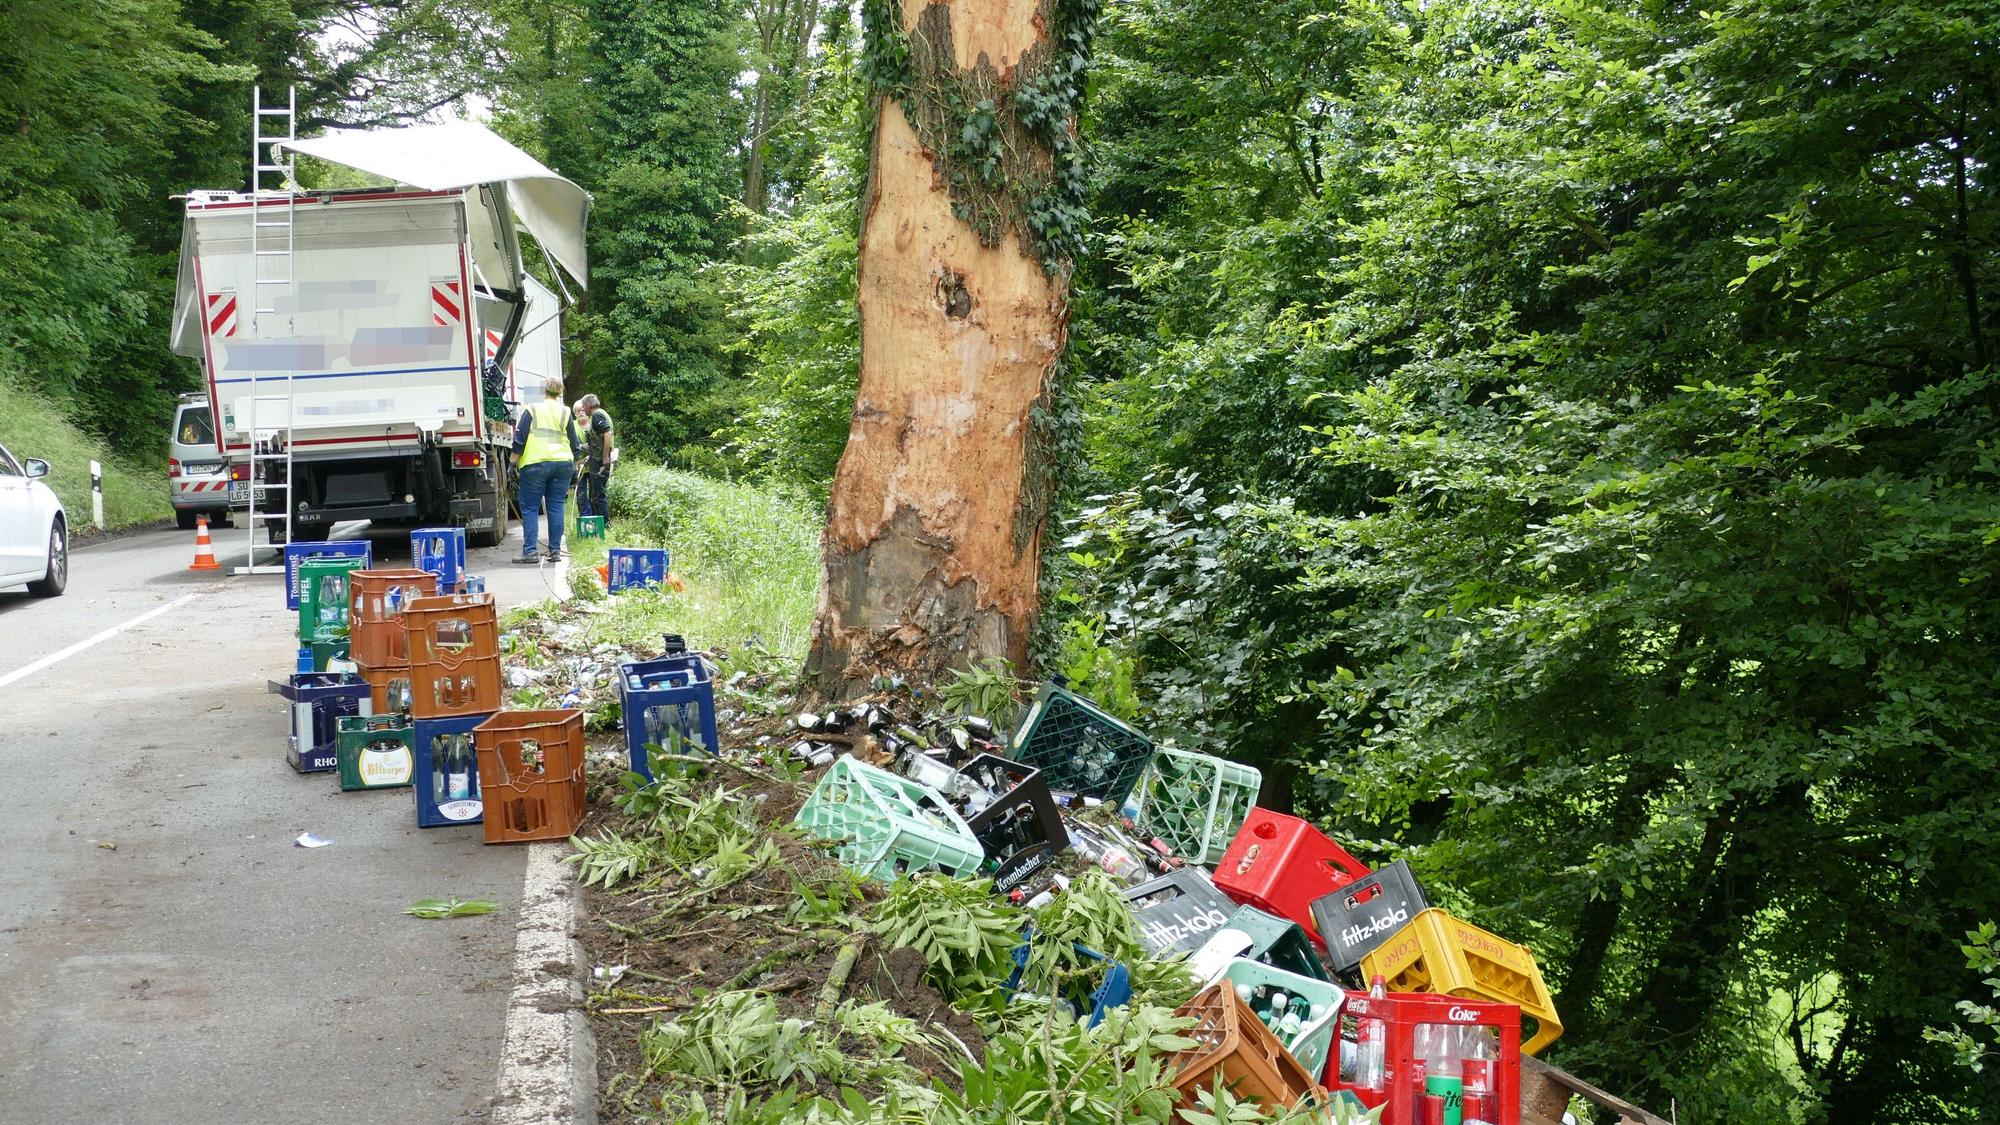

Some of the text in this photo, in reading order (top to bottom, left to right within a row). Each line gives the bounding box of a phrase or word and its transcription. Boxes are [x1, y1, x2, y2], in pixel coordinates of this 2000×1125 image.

[231, 490, 242, 501] LG
[237, 482, 248, 491] SU
[300, 576, 312, 603] EIFEL
[314, 757, 337, 768] RHO
[996, 854, 1041, 892] Krombacher
[1342, 908, 1408, 948] fritz-kola
[1383, 937, 1419, 969] Coke
[1448, 1006, 1477, 1022] Coke
